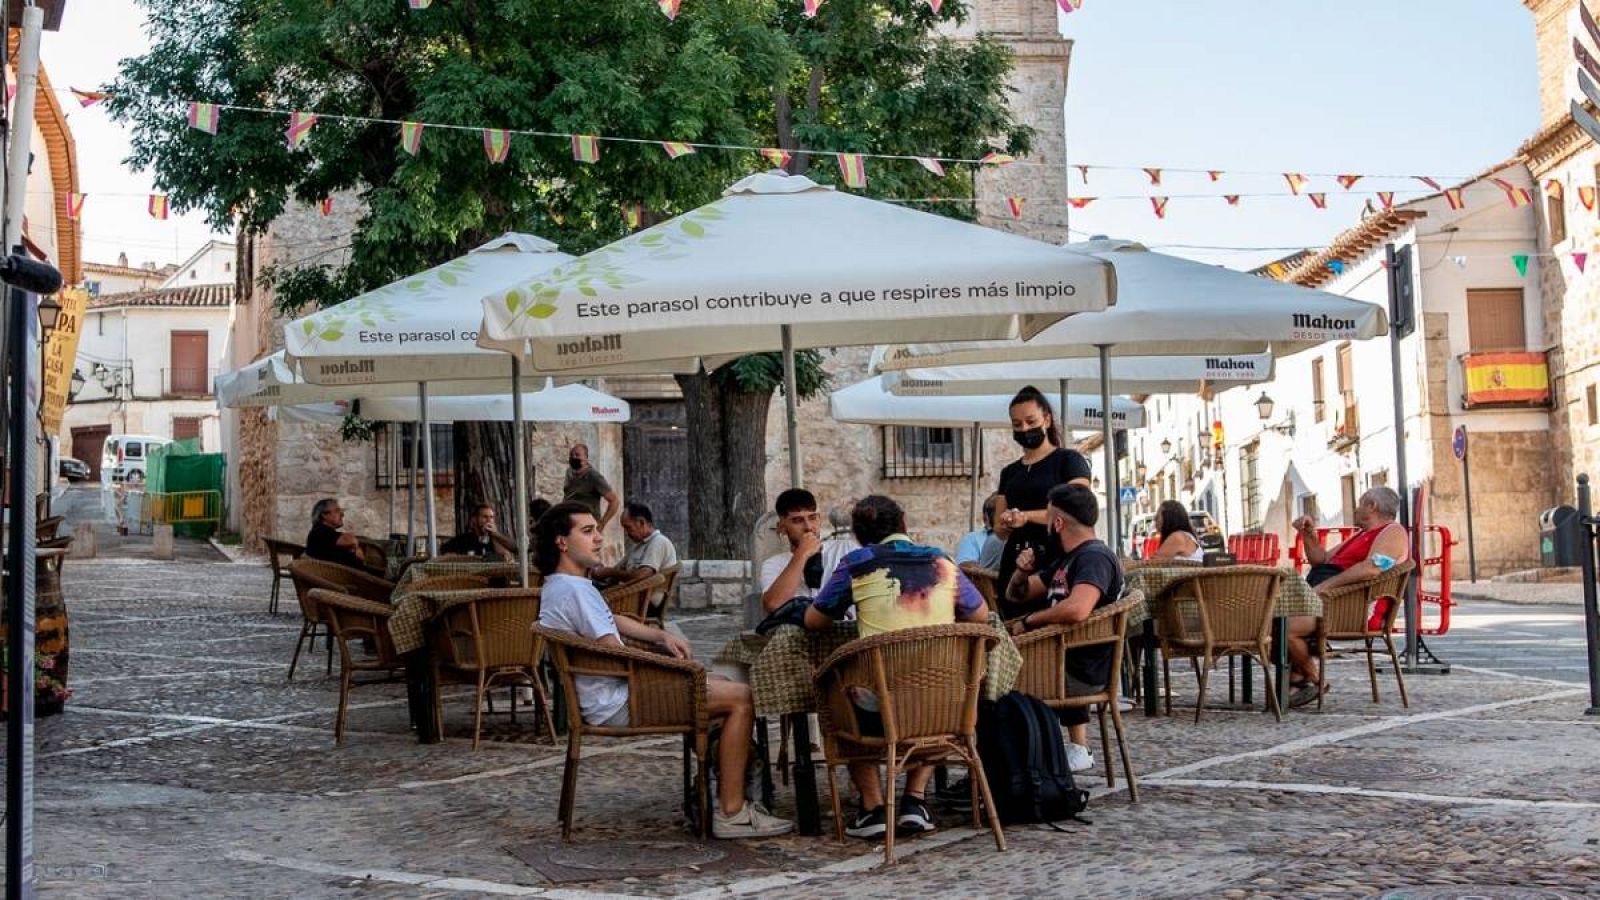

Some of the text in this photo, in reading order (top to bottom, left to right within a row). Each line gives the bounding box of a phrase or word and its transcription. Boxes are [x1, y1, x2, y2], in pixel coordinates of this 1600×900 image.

[576, 281, 1076, 318] Este parasol contribuye a que respires más limpio
[1292, 313, 1356, 330] Mahou
[359, 330, 394, 343] Este
[398, 328, 456, 346] parasol
[1205, 357, 1255, 370] Mahou
[1084, 407, 1126, 420] Maou
